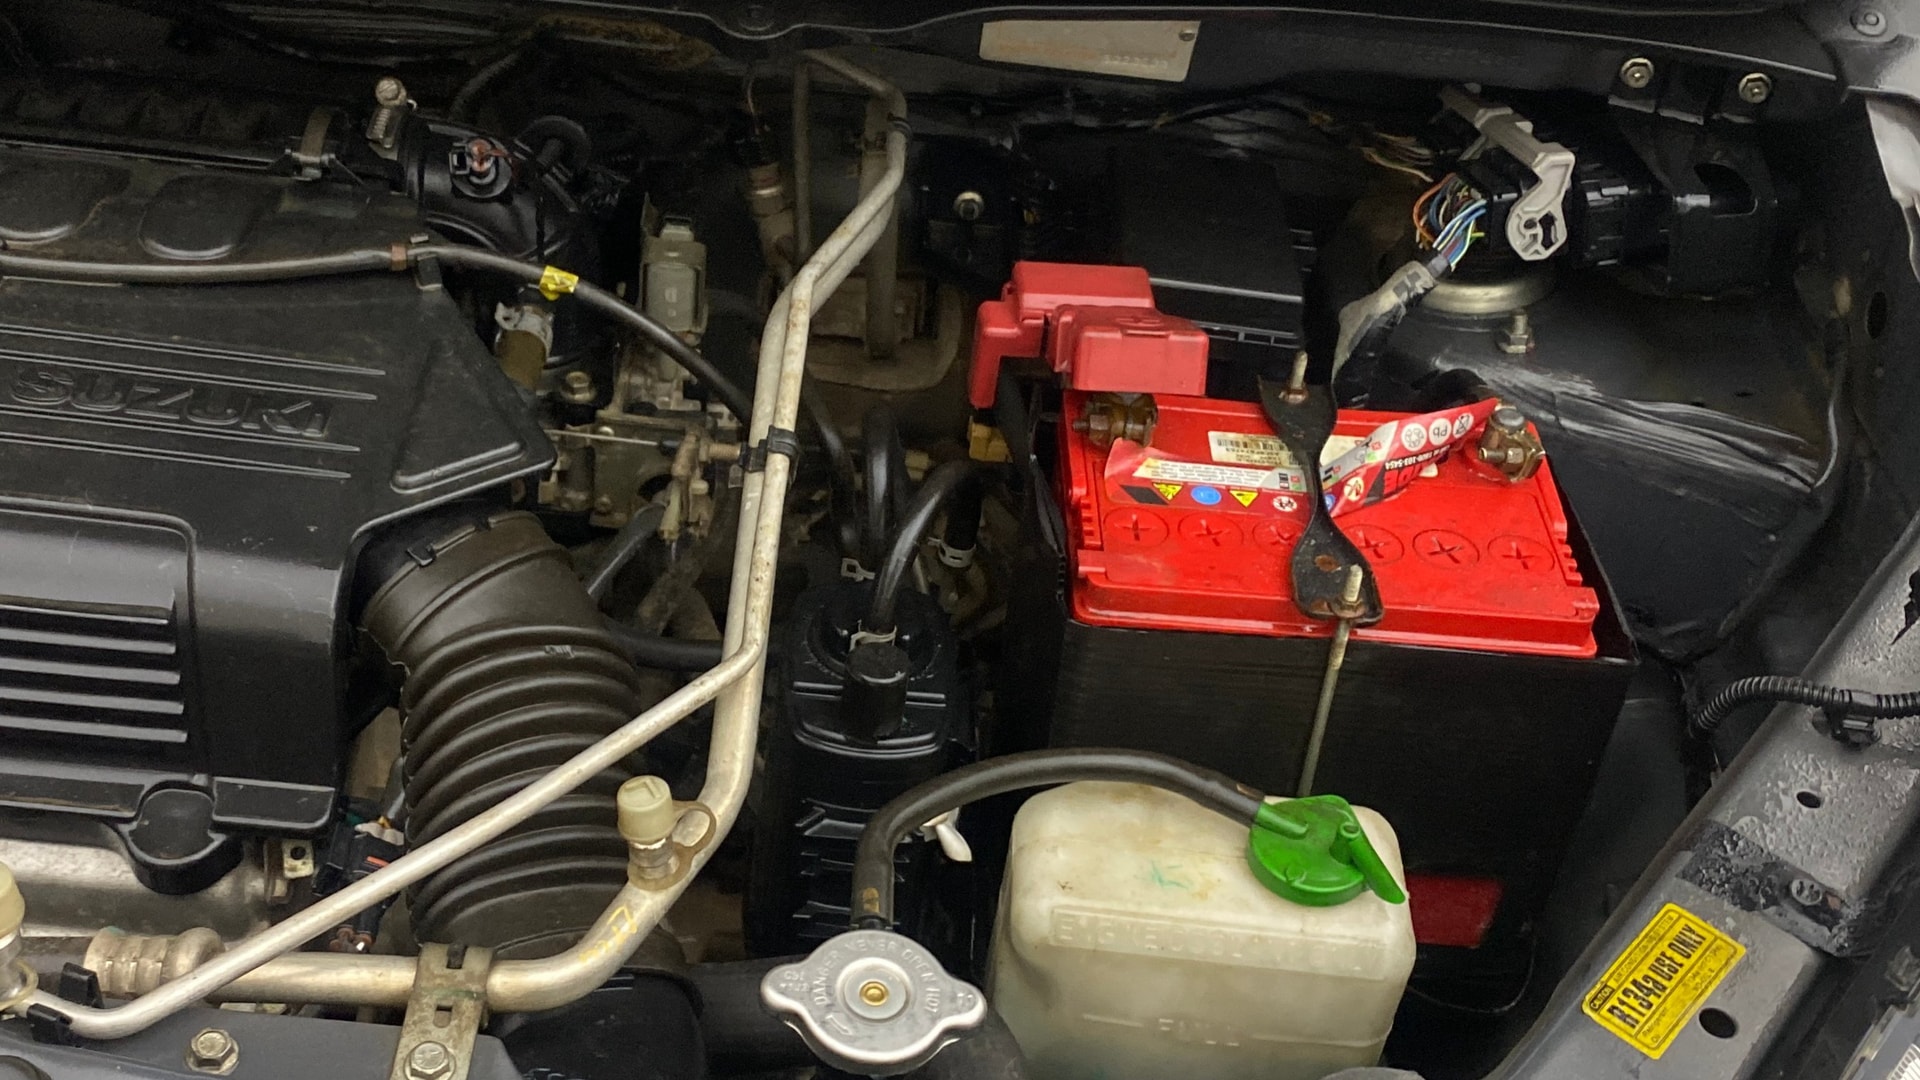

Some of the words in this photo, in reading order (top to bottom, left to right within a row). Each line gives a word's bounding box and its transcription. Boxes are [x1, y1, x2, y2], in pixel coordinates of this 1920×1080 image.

[10, 365, 330, 437] SUZUKI
[812, 950, 843, 1006] DANGER
[844, 938, 898, 952] NEVER
[901, 949, 938, 983] OPEN
[1589, 984, 1613, 1011] CAUTION
[1606, 972, 1668, 1029] R134a
[1648, 950, 1684, 982] USE
[1667, 923, 1707, 960] ONLY
